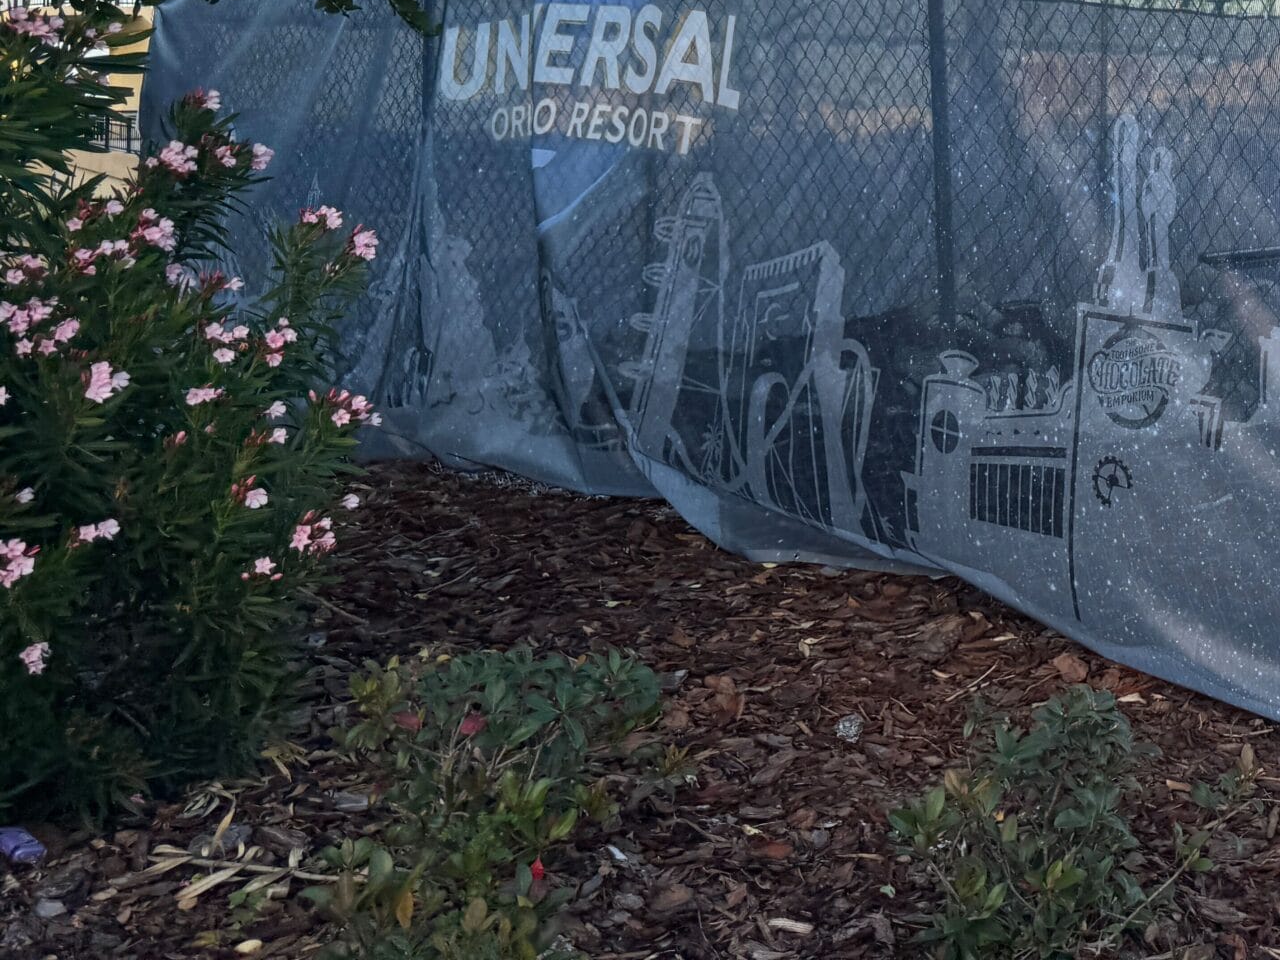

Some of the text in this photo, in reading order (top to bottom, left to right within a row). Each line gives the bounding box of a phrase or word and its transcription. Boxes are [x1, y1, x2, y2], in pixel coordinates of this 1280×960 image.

[566, 101, 702, 156] RESORT
[1111, 342, 1156, 359] TOOTHSOME
[1087, 350, 1181, 393] CHOCOLATE
[1106, 389, 1155, 408] EMPORIUM
